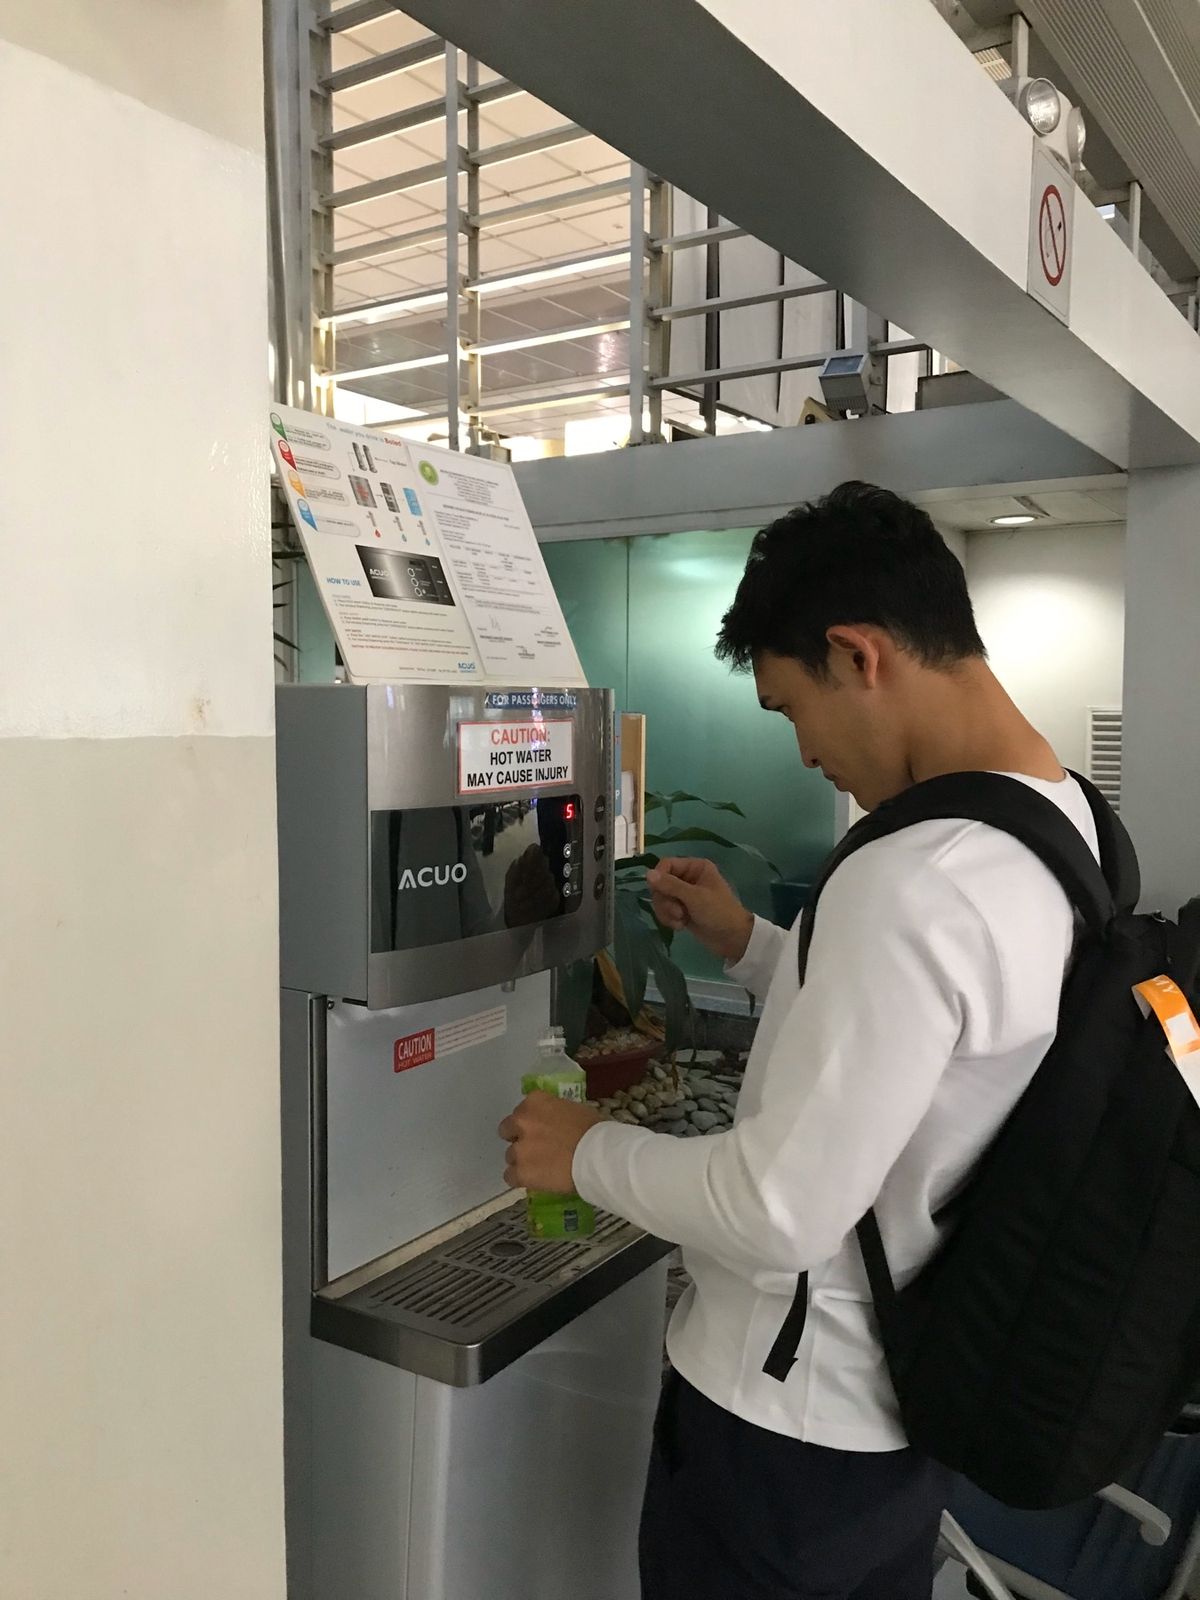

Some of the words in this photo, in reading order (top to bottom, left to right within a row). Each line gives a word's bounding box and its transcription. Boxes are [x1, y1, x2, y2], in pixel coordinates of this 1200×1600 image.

[326, 577, 341, 585] HOW
[457, 662, 476, 670] ACUO
[492, 695, 509, 705] FOR
[559, 695, 577, 705] ONLY
[491, 728, 550, 745] CAUTION:
[490, 751, 514, 766] HOT
[515, 749, 552, 765] WATER
[467, 772, 494, 787] MAY
[496, 769, 533, 784] CAUSE
[535, 766, 569, 781] INJURY
[566, 803, 573, 819] 5
[398, 862, 467, 890] ACUO
[398, 1033, 432, 1060] CAUTION
[398, 1056, 411, 1069] HOT
